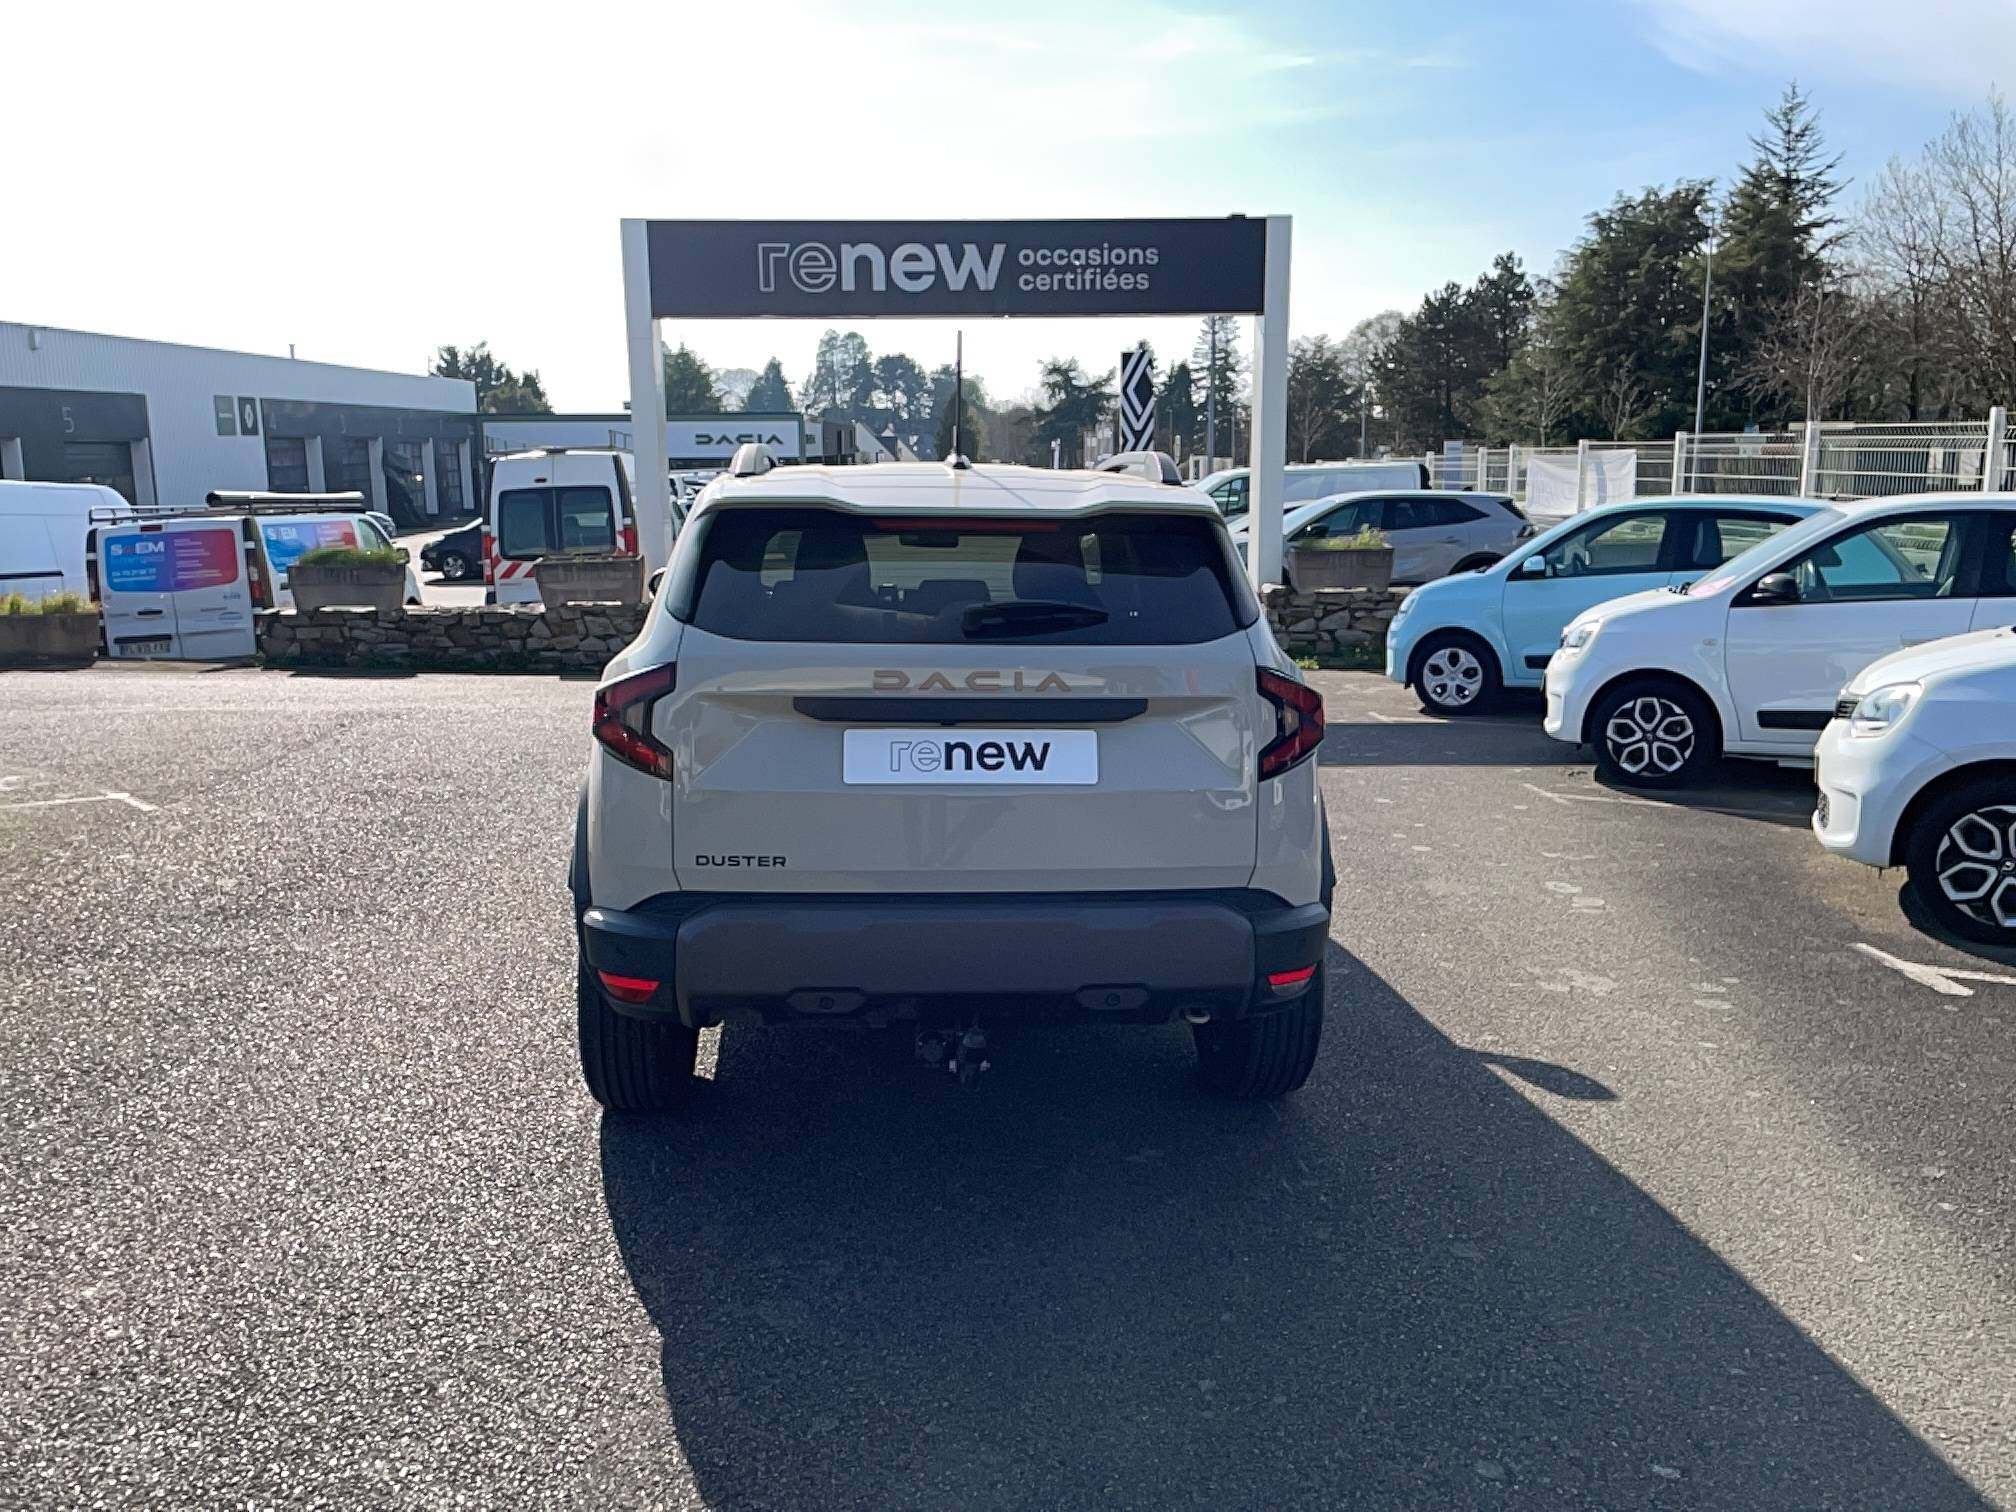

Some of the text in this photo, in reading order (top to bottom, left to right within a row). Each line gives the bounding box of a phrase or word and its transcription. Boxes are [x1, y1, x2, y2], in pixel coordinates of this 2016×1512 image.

[1018, 243, 1160, 266] occasions
[758, 242, 1006, 293] renew
[1018, 267, 1150, 291] certifiées
[62, 406, 75, 433] 5
[695, 433, 784, 446] DACIA
[872, 670, 1073, 692] DACIA
[890, 740, 1050, 772] renew
[695, 855, 787, 867] DUSTER
